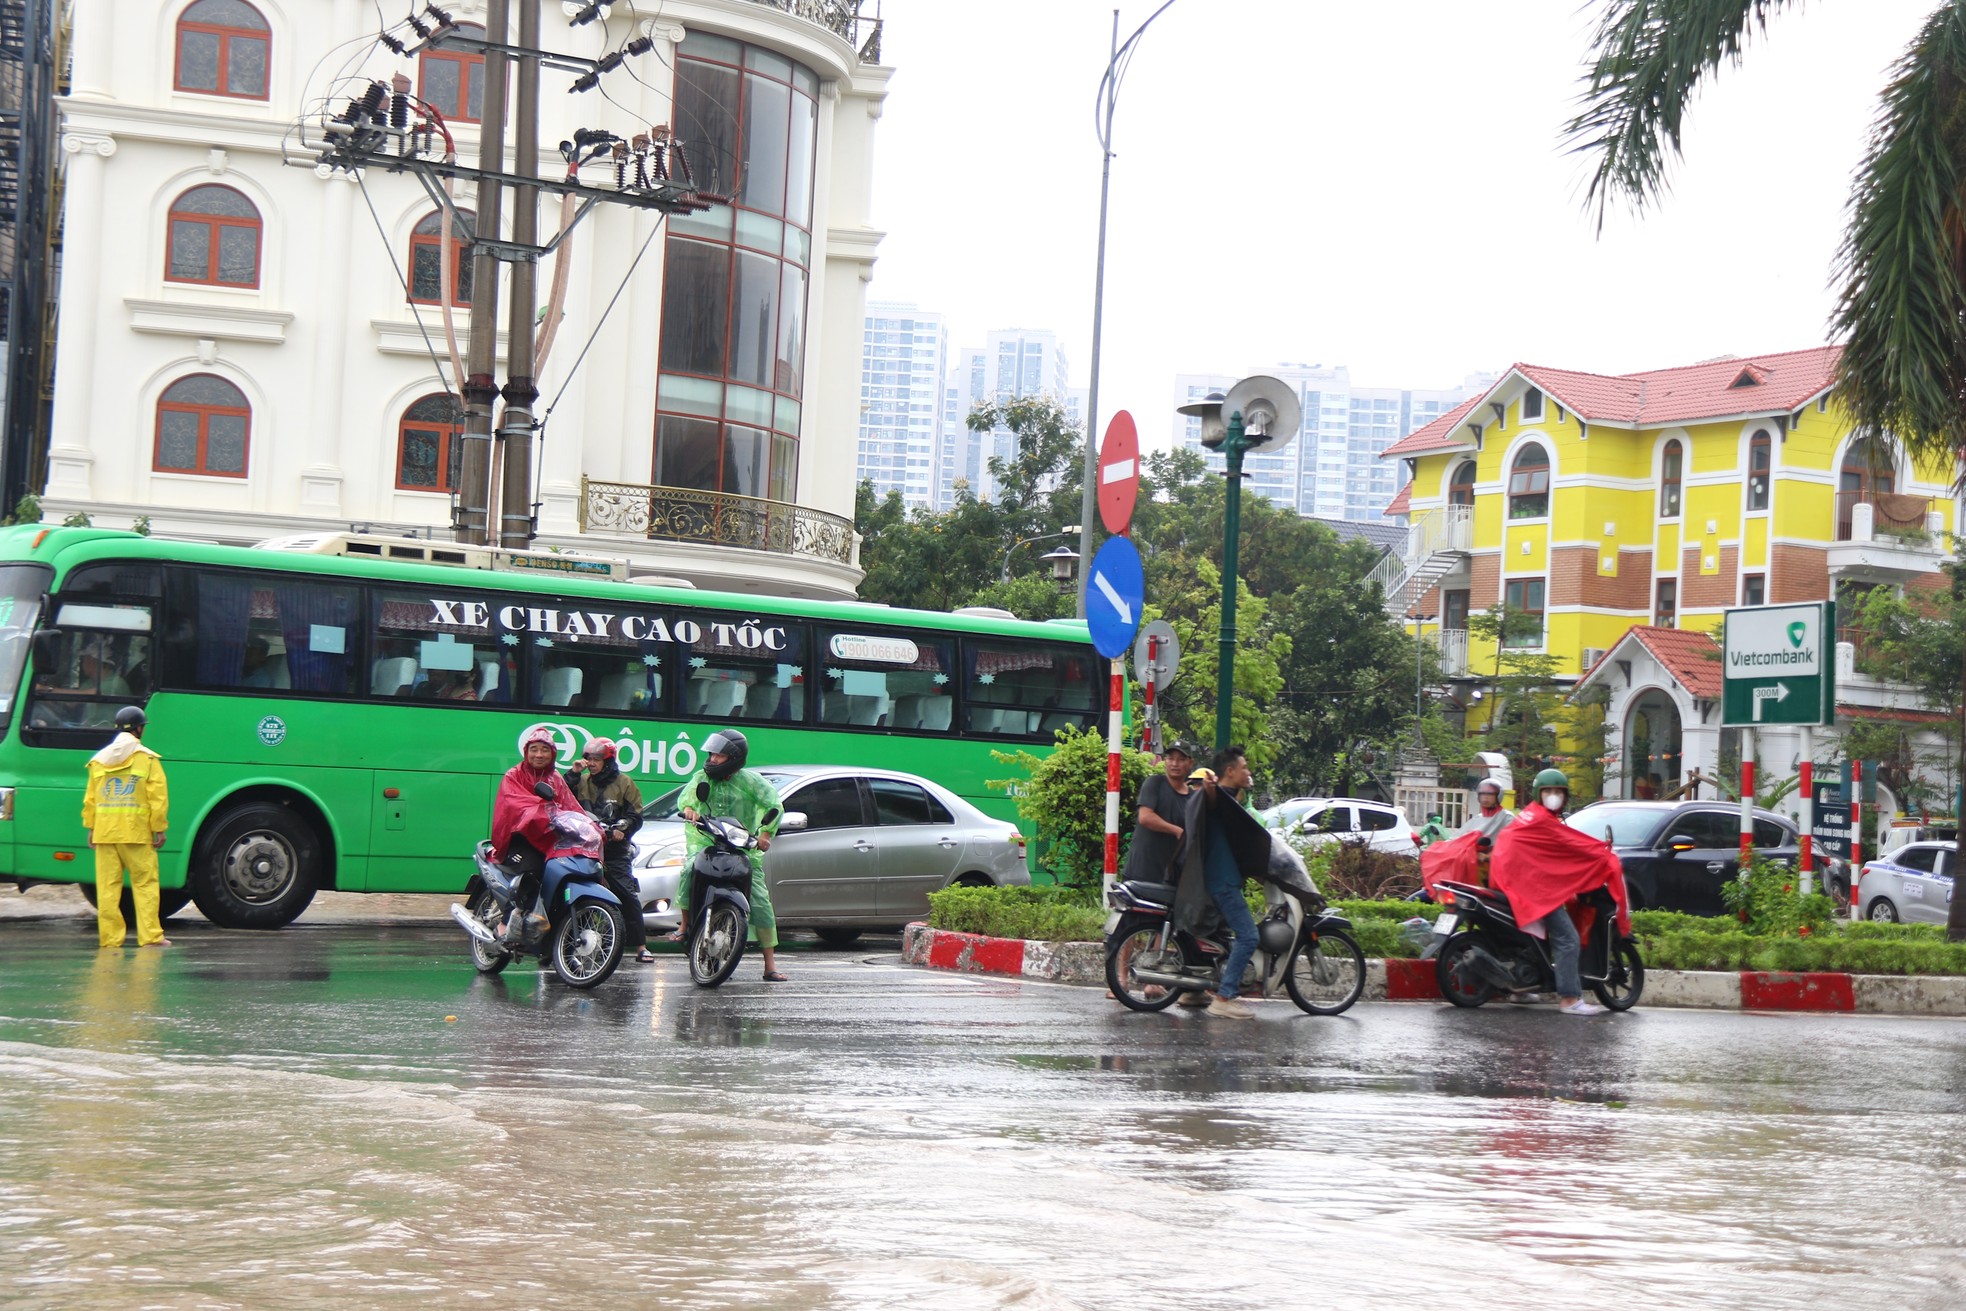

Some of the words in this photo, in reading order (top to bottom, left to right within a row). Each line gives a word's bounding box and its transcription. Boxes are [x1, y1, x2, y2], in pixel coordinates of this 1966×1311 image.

[428, 599, 490, 628] XE
[499, 605, 616, 643] CHẠY
[621, 616, 702, 644] CAO
[711, 618, 787, 651] TỐC
[842, 643, 869, 657] 1900
[871, 644, 892, 659] 066
[894, 646, 914, 660] 646
[1730, 647, 1813, 667] Vietcombank
[1755, 688, 1779, 698] 300M
[615, 727, 697, 776] ÔHÔ
